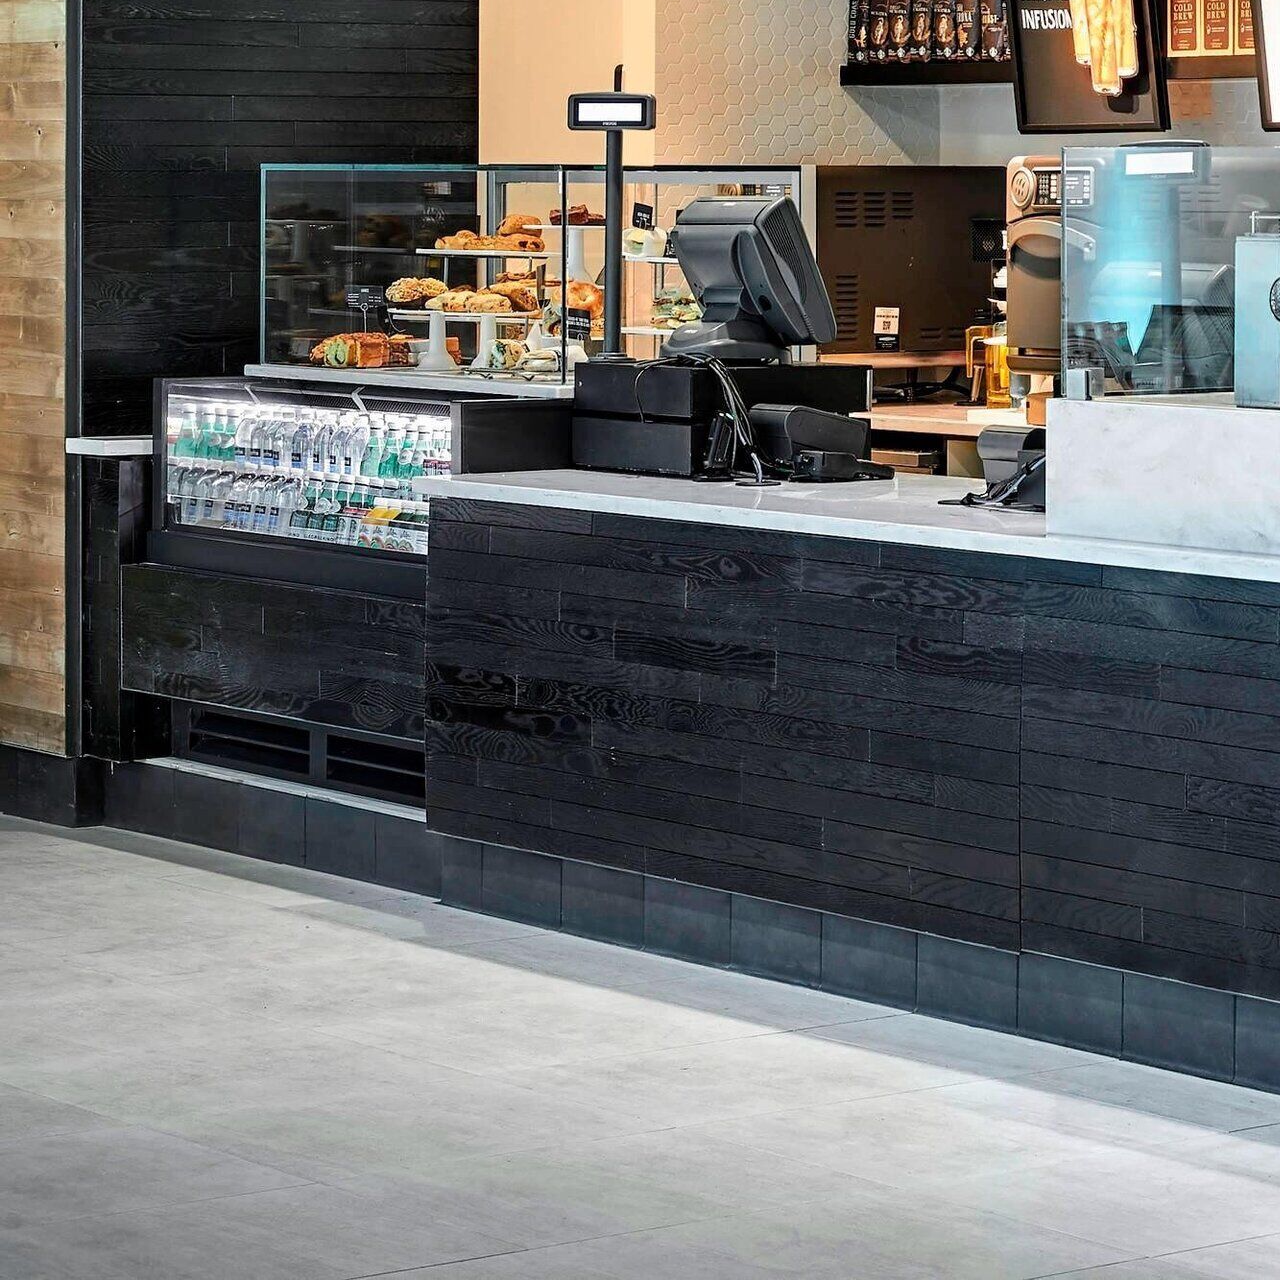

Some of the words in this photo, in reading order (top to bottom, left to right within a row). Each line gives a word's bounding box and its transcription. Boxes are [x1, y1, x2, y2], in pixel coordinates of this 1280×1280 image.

[1174, 4, 1192, 12] COLD
[1206, 2, 1226, 10] COLD
[1174, 12, 1194, 20] BREW
[1206, 10, 1226, 19] BREW
